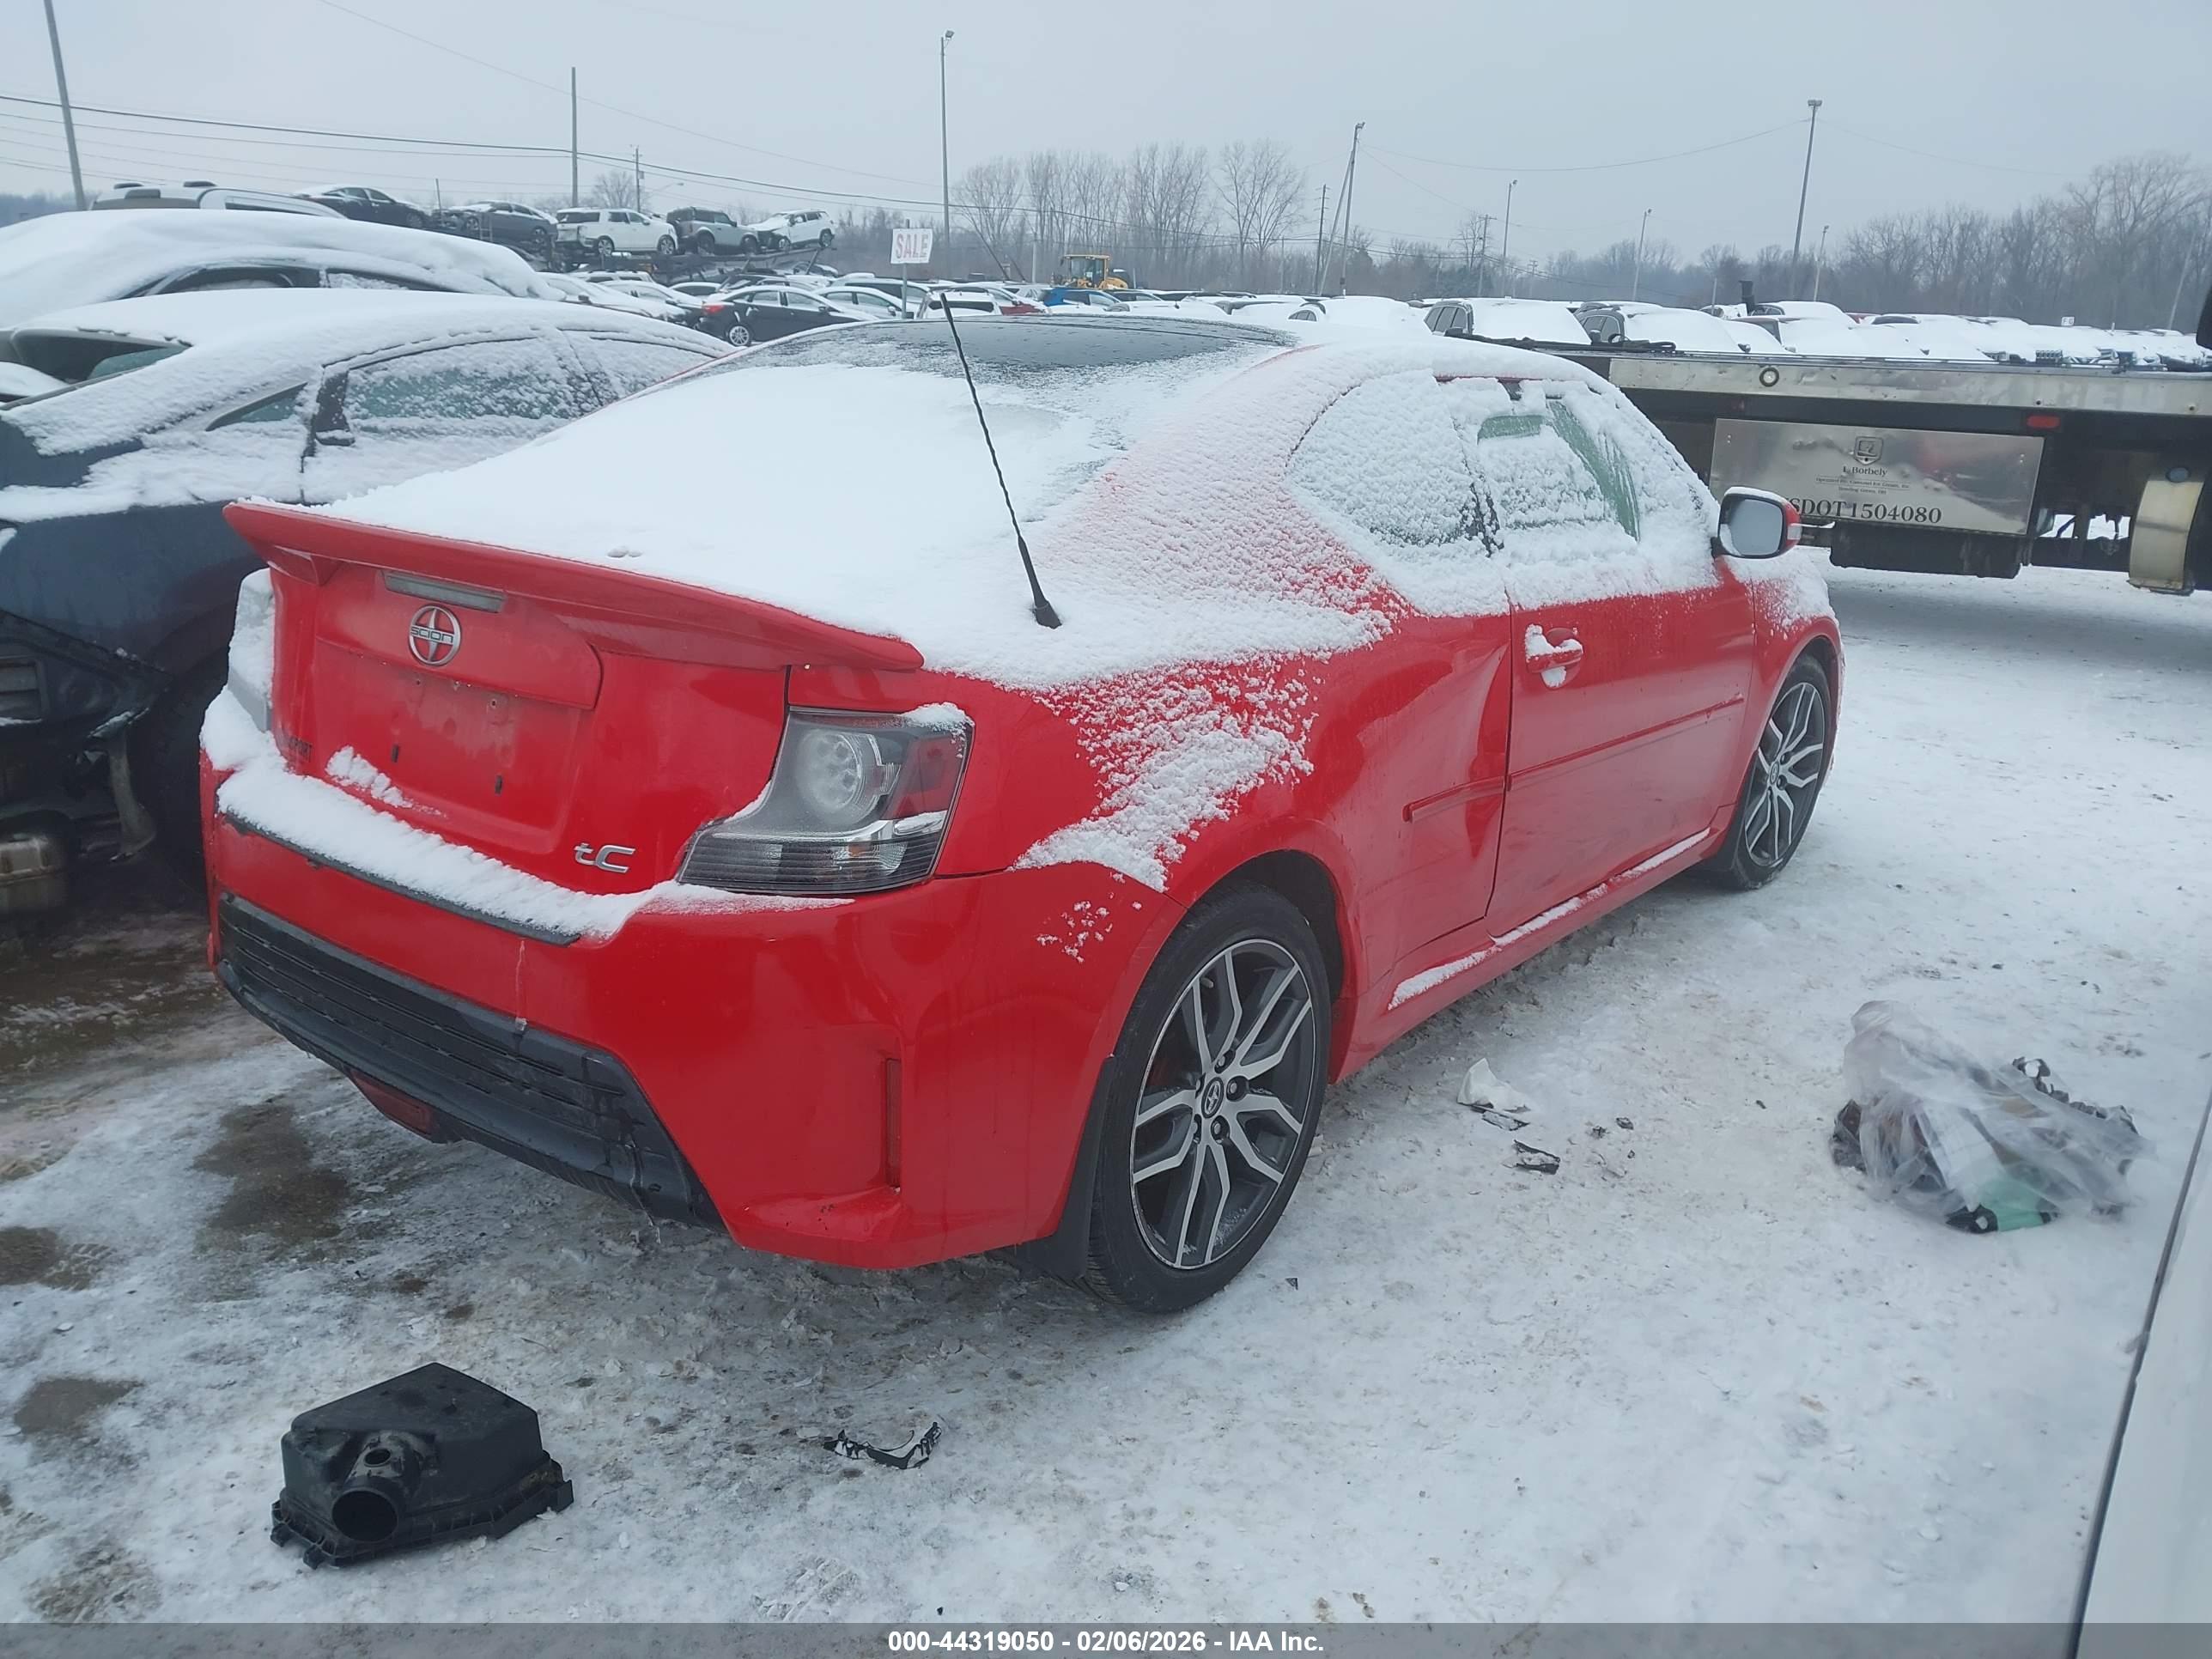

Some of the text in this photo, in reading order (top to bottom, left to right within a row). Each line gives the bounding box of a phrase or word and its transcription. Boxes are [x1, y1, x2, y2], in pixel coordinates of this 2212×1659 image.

[895, 233, 929, 259] SALE
[1787, 497, 1942, 524] SDOT1504080
[573, 842, 636, 874] tC
